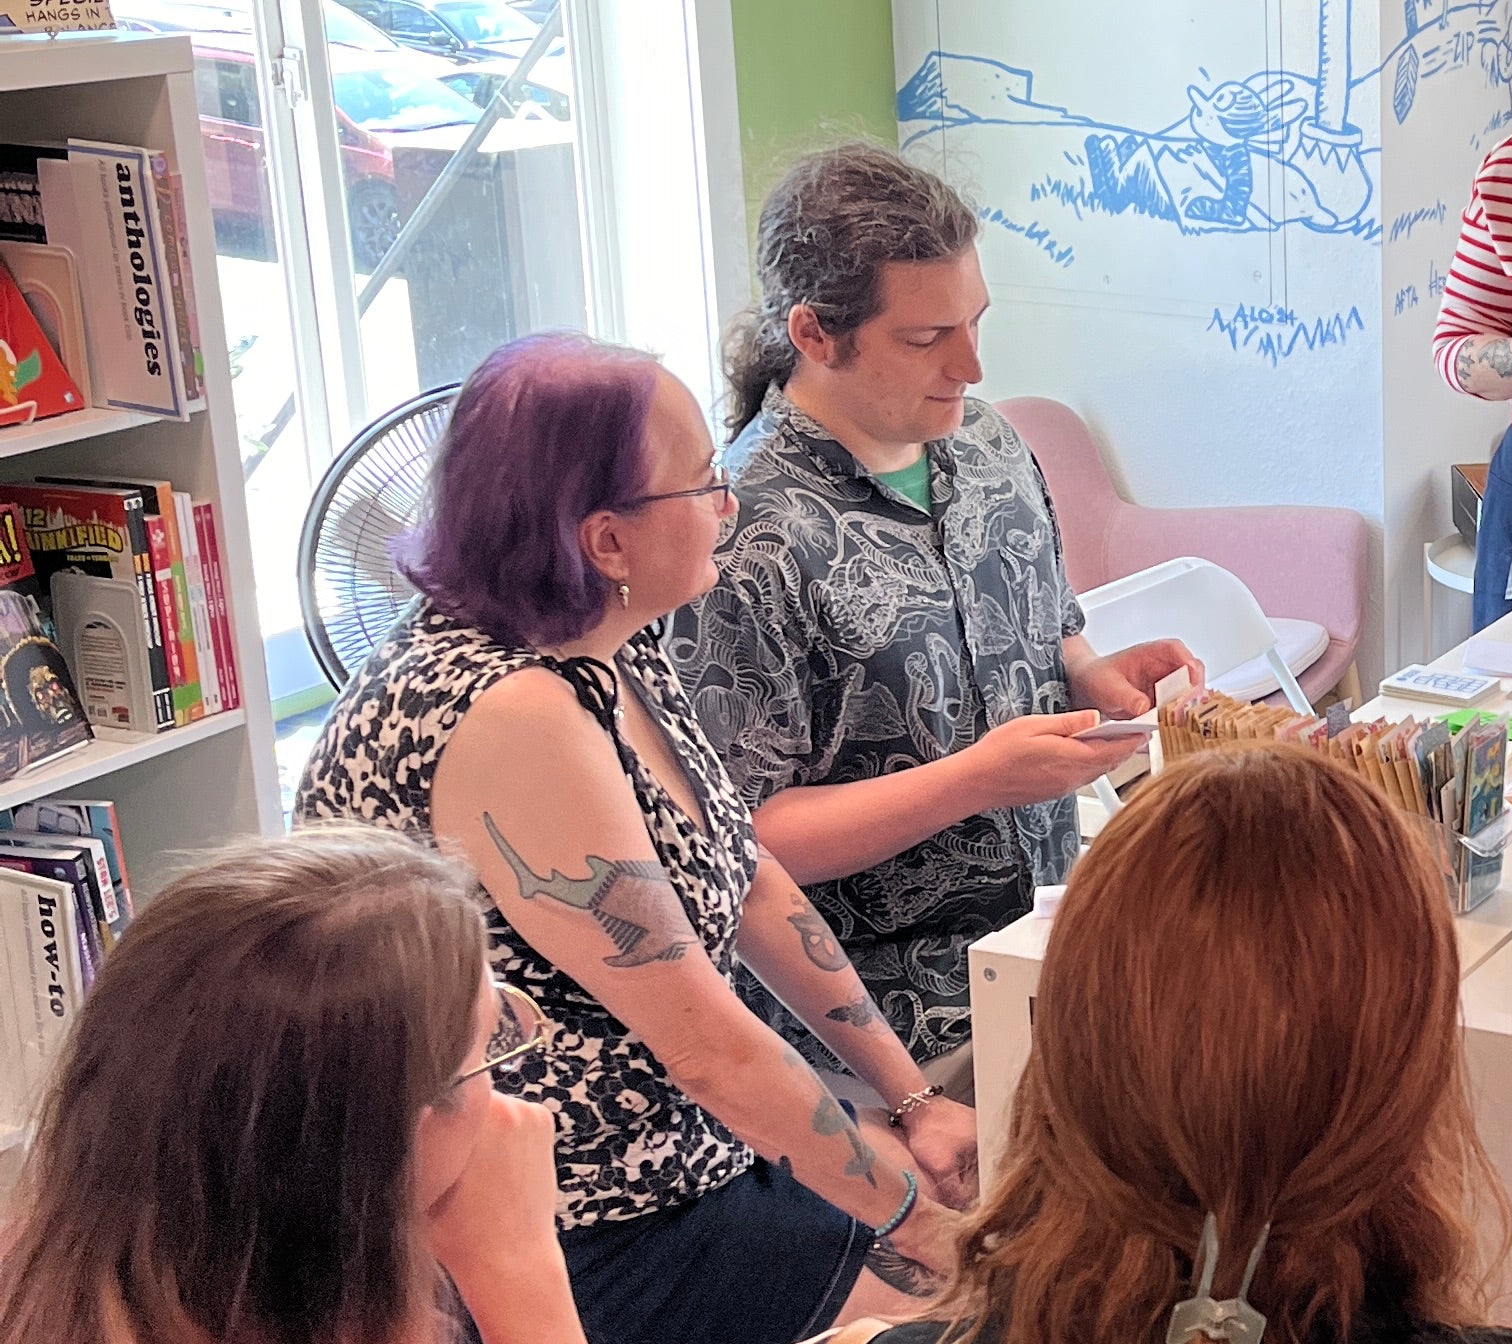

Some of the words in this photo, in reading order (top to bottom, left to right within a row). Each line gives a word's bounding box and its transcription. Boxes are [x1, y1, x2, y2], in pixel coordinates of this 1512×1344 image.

[25, 8, 81, 23] HANGS
[85, 8, 100, 19] IN
[1453, 31, 1475, 66] ZIP
[115, 162, 161, 377] anthologies
[37, 894, 65, 1018] how-to
